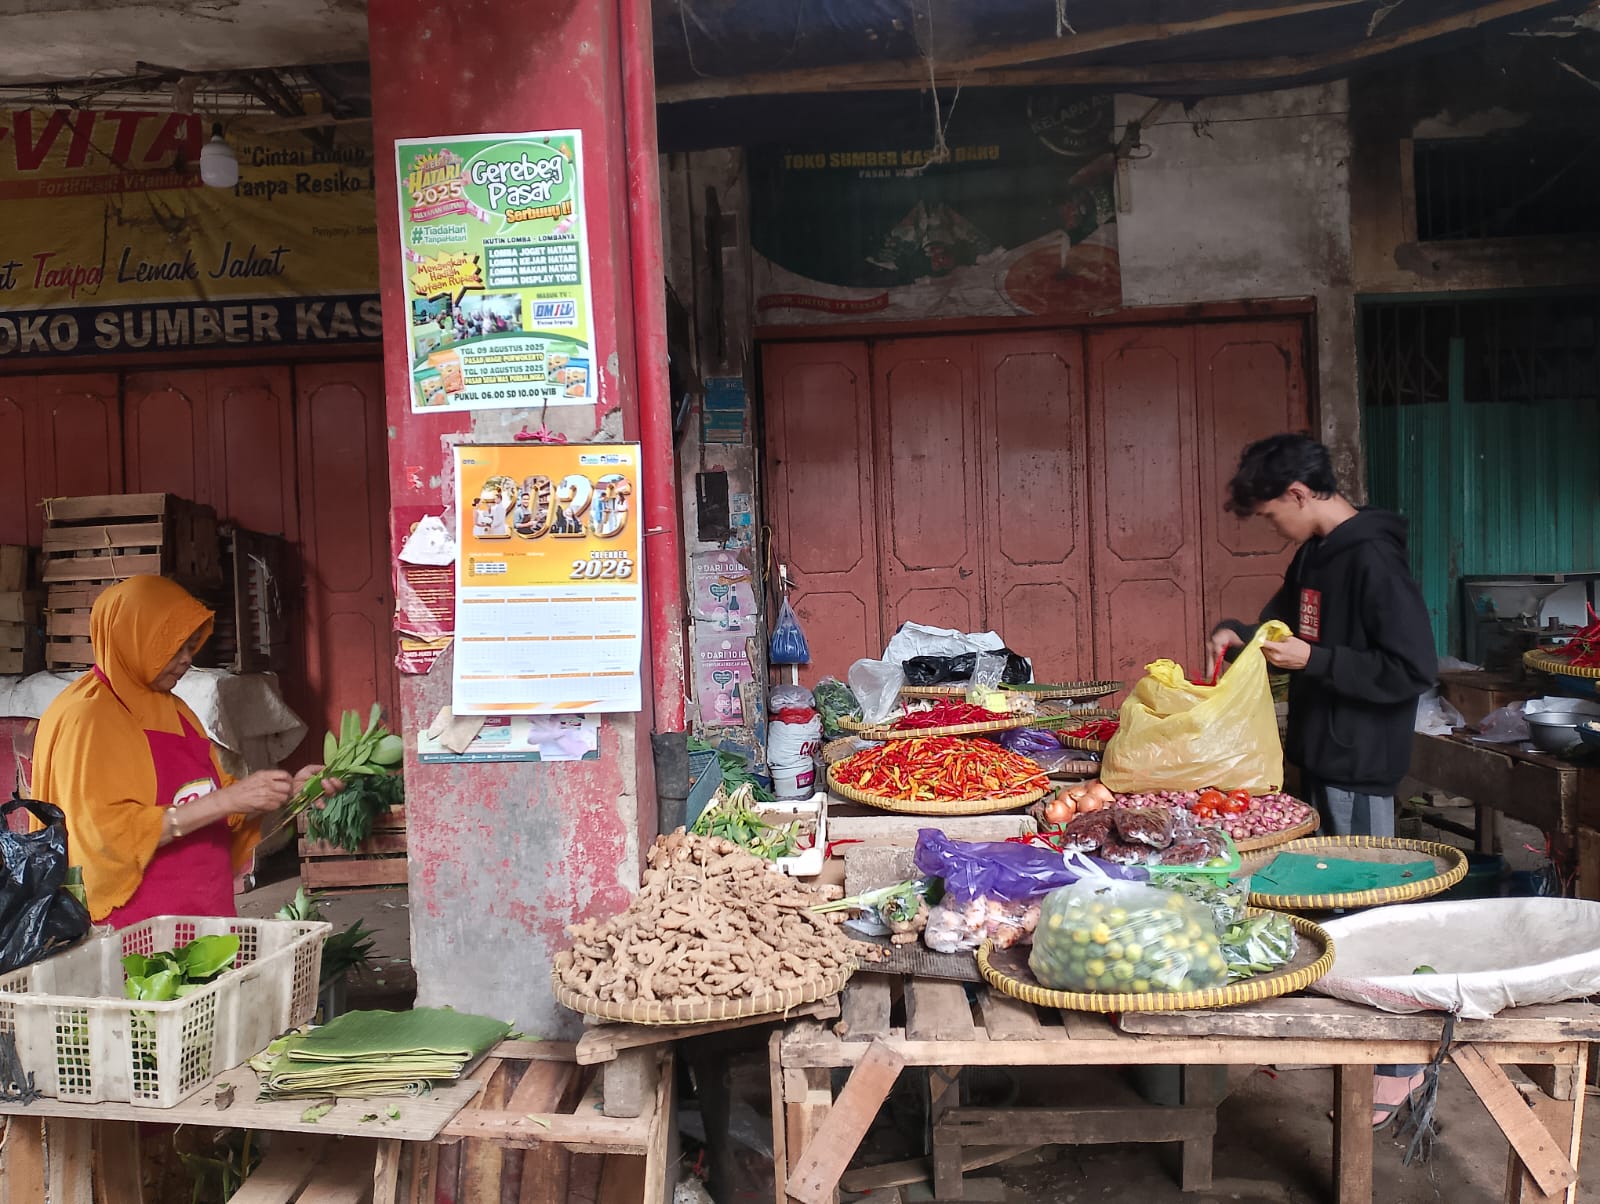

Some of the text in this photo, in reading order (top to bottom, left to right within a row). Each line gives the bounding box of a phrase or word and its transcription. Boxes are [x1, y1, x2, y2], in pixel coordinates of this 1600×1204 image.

[784, 153, 826, 169] TOKO
[830, 151, 897, 168] SUMBER
[472, 152, 563, 184] Gerebeg
[234, 175, 288, 200] Tanpa
[295, 169, 361, 194] Resiko
[412, 181, 462, 207] 2025
[487, 178, 555, 210] Pasar
[507, 236, 532, 244] LOMBA
[538, 234, 575, 242] LOMBANYA
[489, 248, 518, 258] LOMBA
[489, 257, 518, 267] LOMBA
[33, 252, 102, 299] Tanpa
[117, 246, 199, 284] Lemak
[208, 241, 291, 280] Jahat
[489, 267, 518, 276] LOMBA
[489, 273, 577, 286] LOMBA DISPLAY TOKO
[94, 304, 282, 350] SUMBER
[489, 345, 523, 353] AGUSTUS
[525, 343, 545, 351] 2025
[490, 365, 523, 374] AGUSTUS
[525, 364, 544, 372] 2025
[454, 387, 557, 401] PUKUL 06.00 SD 10.00 WIB
[472, 473, 633, 540] 2026
[569, 559, 634, 580] 2026
[703, 564, 723, 572] DARI
[725, 563, 734, 571] 10
[707, 651, 726, 660] DARI
